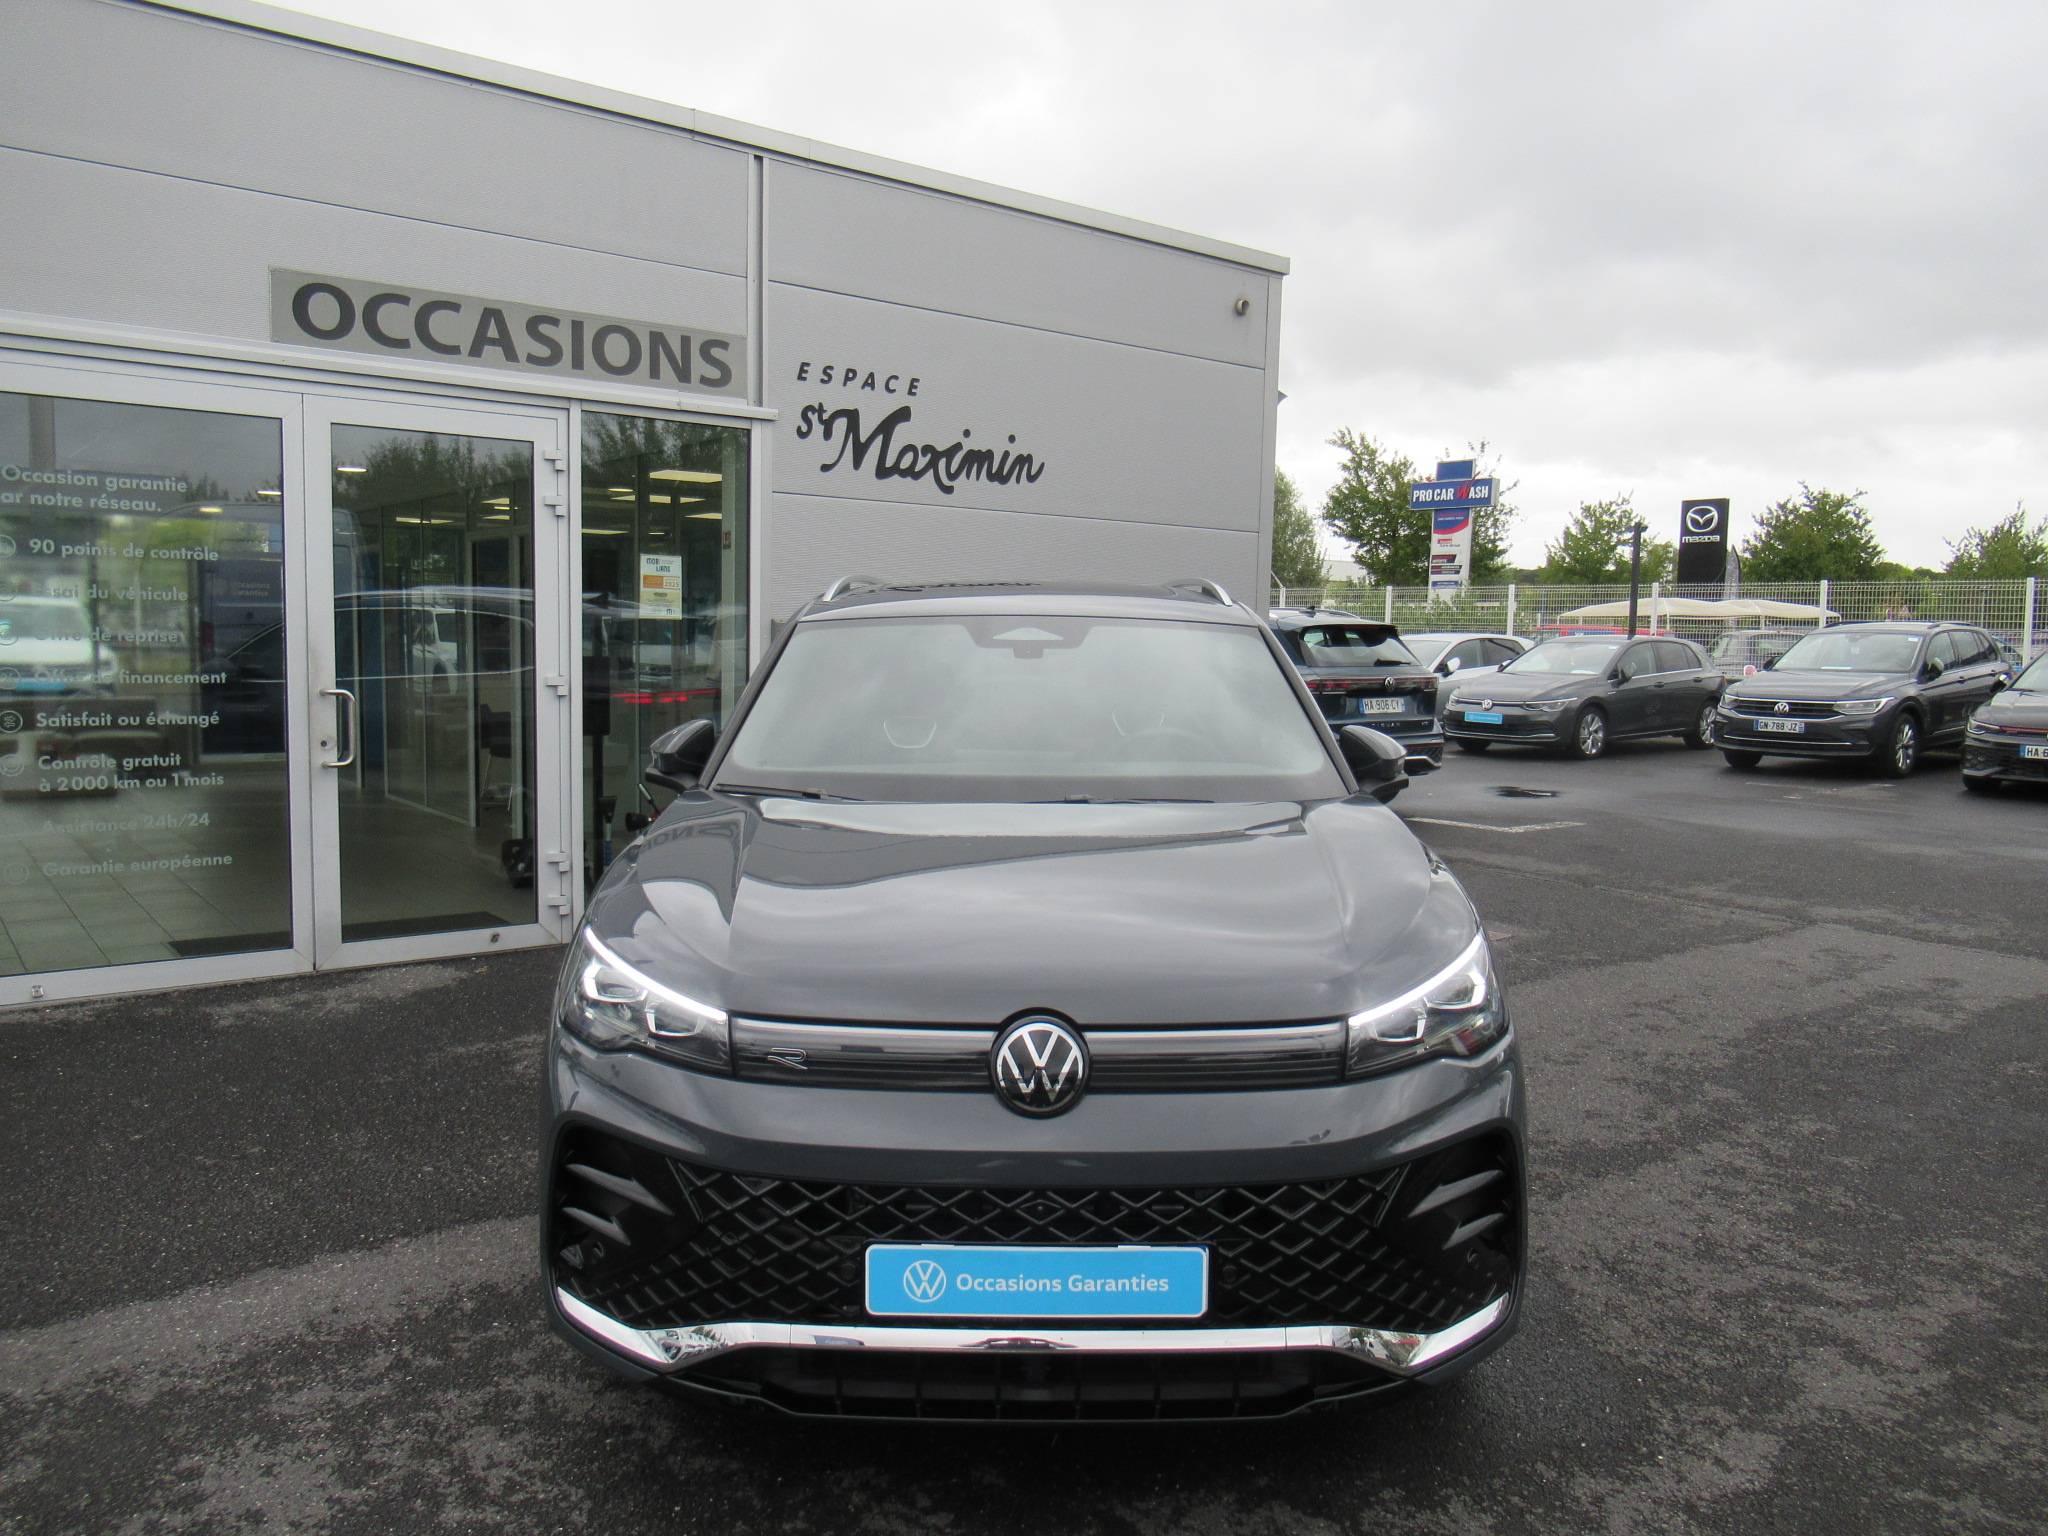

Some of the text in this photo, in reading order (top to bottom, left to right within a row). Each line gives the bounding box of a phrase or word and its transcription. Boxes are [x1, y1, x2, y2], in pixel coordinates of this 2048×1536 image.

[291, 282, 733, 388] OCCASIONS
[797, 361, 920, 396] ESPACE
[820, 405, 1045, 495] Maximin
[2, 464, 188, 493] Occasion garantie
[1412, 478, 1489, 502] PRO CAR WASH
[0, 491, 162, 512] ar notre réseau.
[29, 538, 55, 554] 90
[123, 542, 145, 559] de
[150, 545, 219, 562] contrôle
[89, 584, 109, 600] du
[116, 586, 189, 601] véhicule
[91, 627, 112, 642] de
[117, 629, 178, 647] reprise
[119, 669, 228, 685] financement
[36, 711, 221, 728] Satisfait ou échangé
[38, 753, 182, 771] Contrôle gratuit
[2026, 747, 2048, 758] HA-6
[39, 778, 50, 792] à
[114, 777, 141, 790] km
[145, 778, 167, 789] ou
[184, 773, 225, 787] mois
[143, 812, 210, 829] 24h/24
[43, 854, 233, 877] Garantie européenne
[956, 1274, 1062, 1293] Occasions
[1068, 1274, 1169, 1293] Garanties
